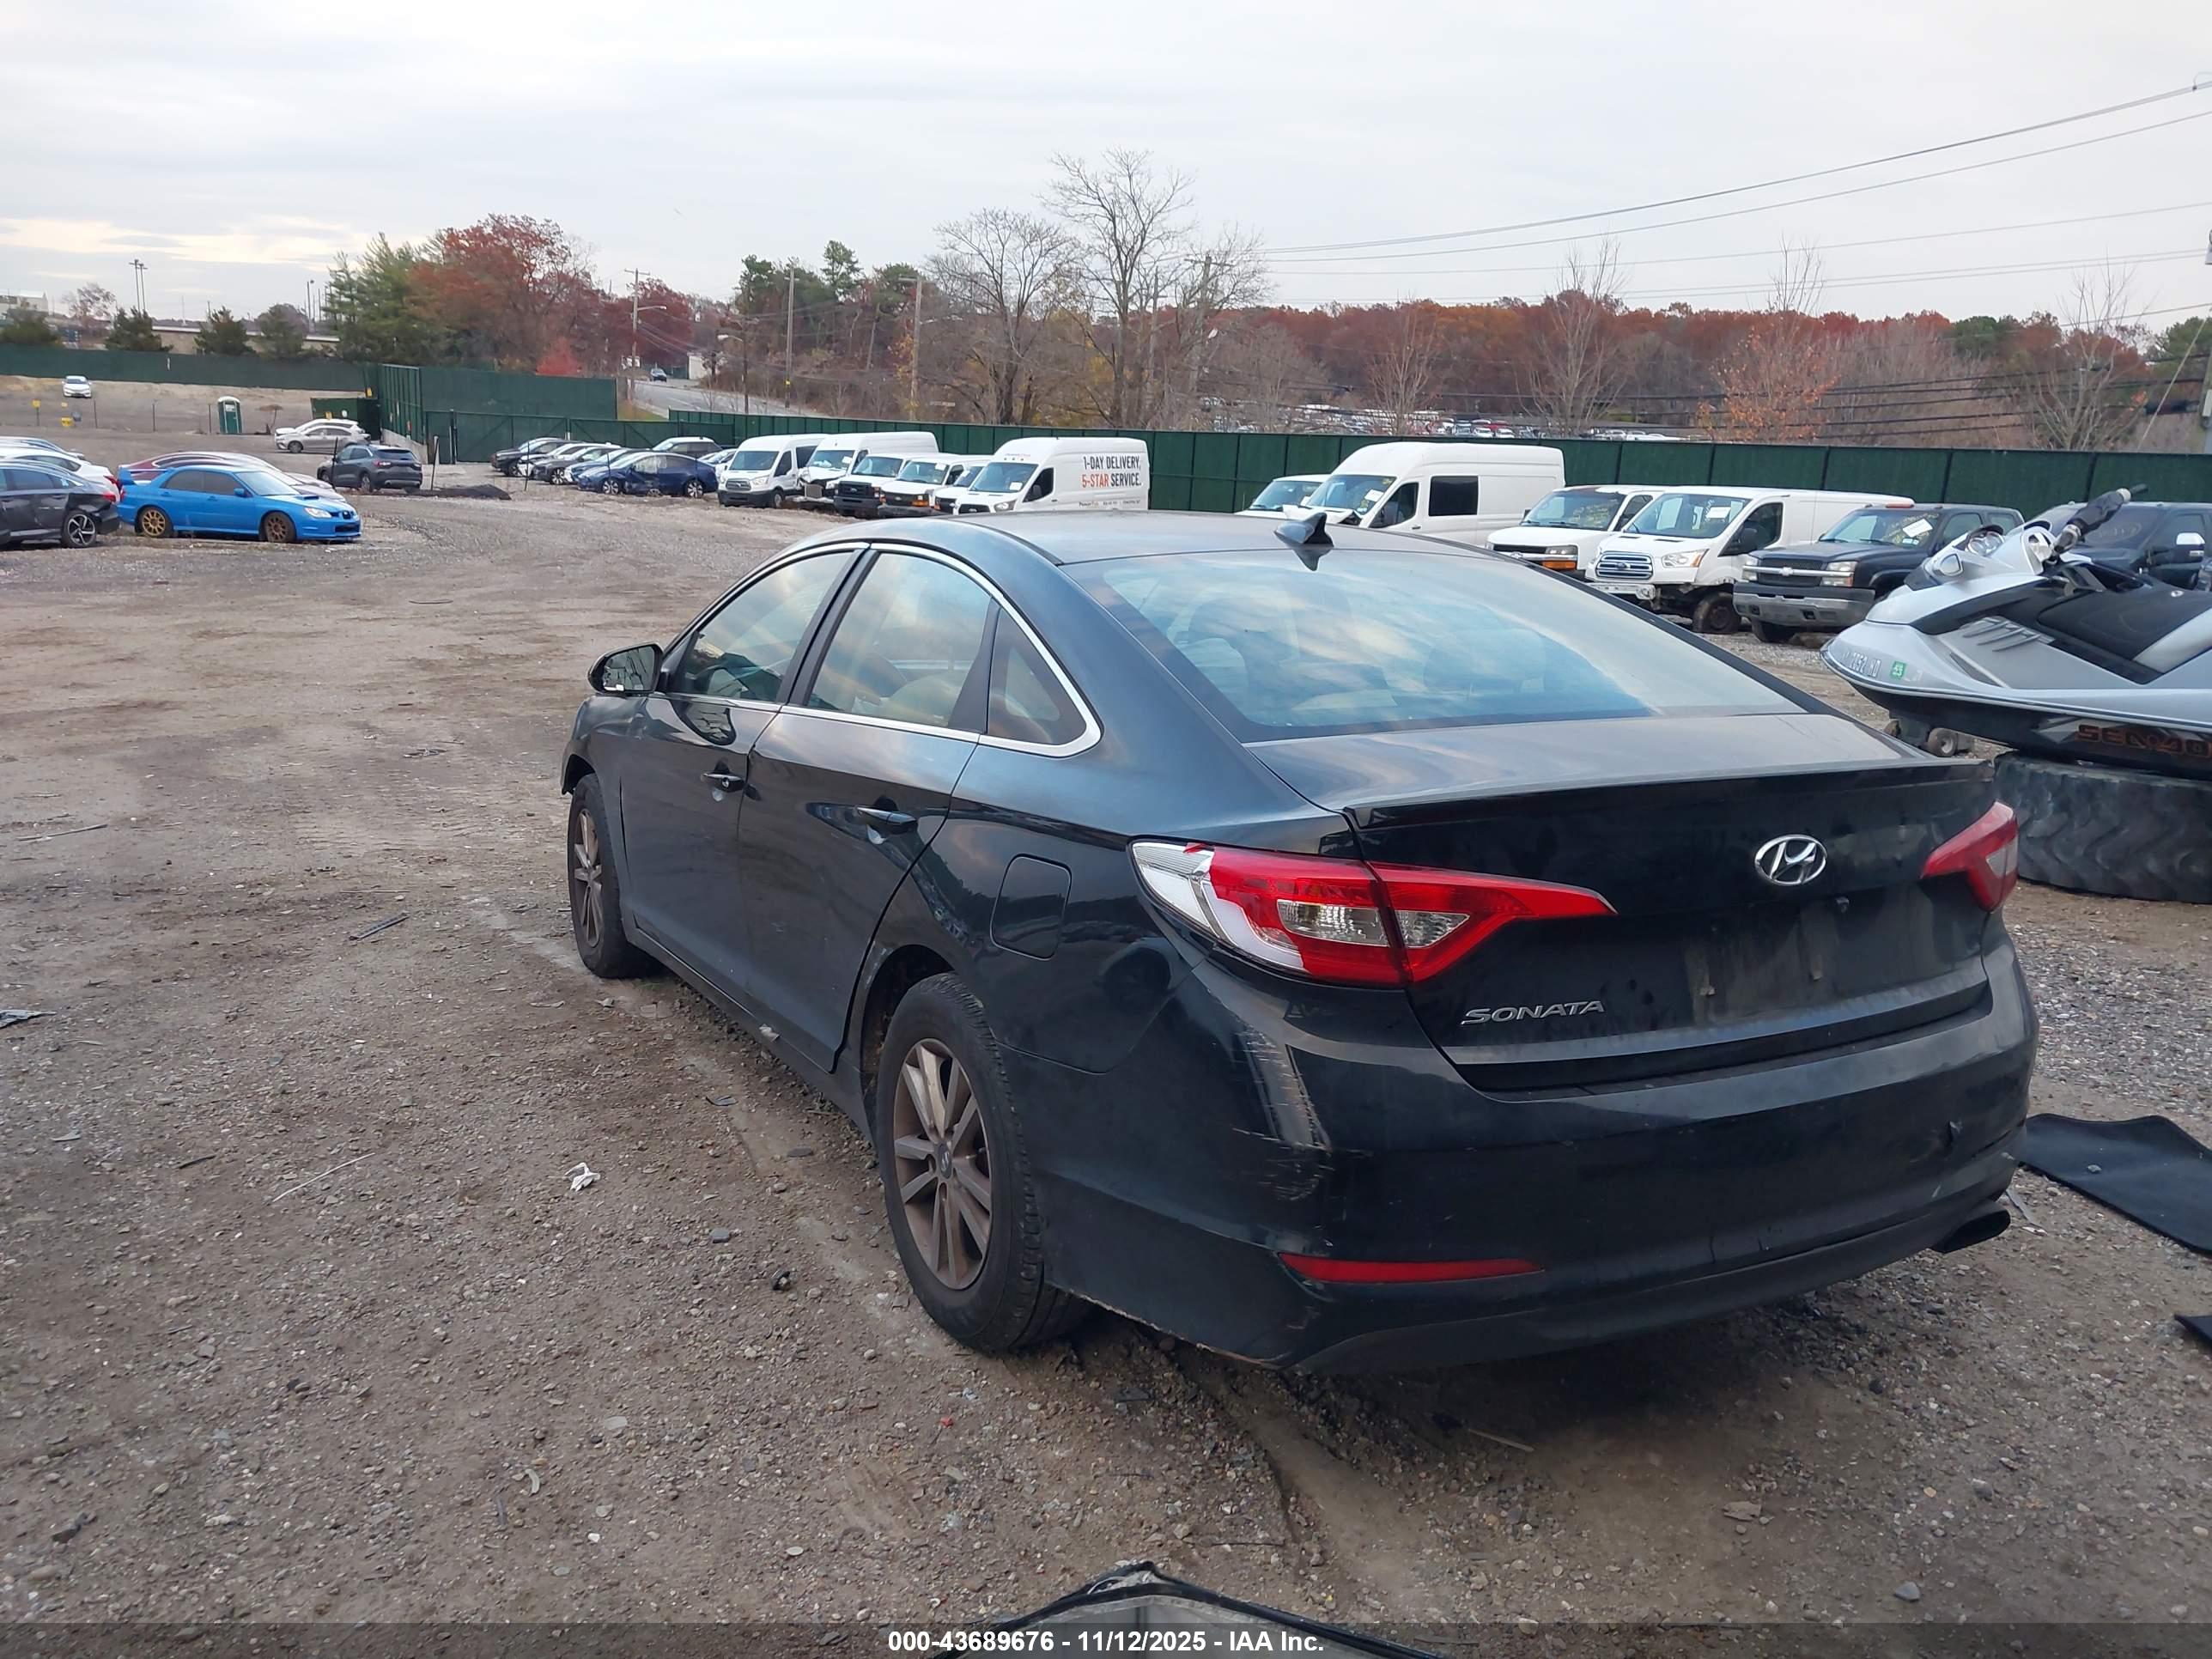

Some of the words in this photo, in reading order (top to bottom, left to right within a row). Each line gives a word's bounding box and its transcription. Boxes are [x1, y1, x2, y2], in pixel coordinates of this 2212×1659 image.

[1083, 455, 1104, 470] 1-DAY
[1106, 455, 1141, 471] DELIVERY,
[1082, 473, 1109, 488] 5-STAR
[1110, 472, 1142, 487] SERVICE.
[1460, 1000, 1605, 1024] SONATA
